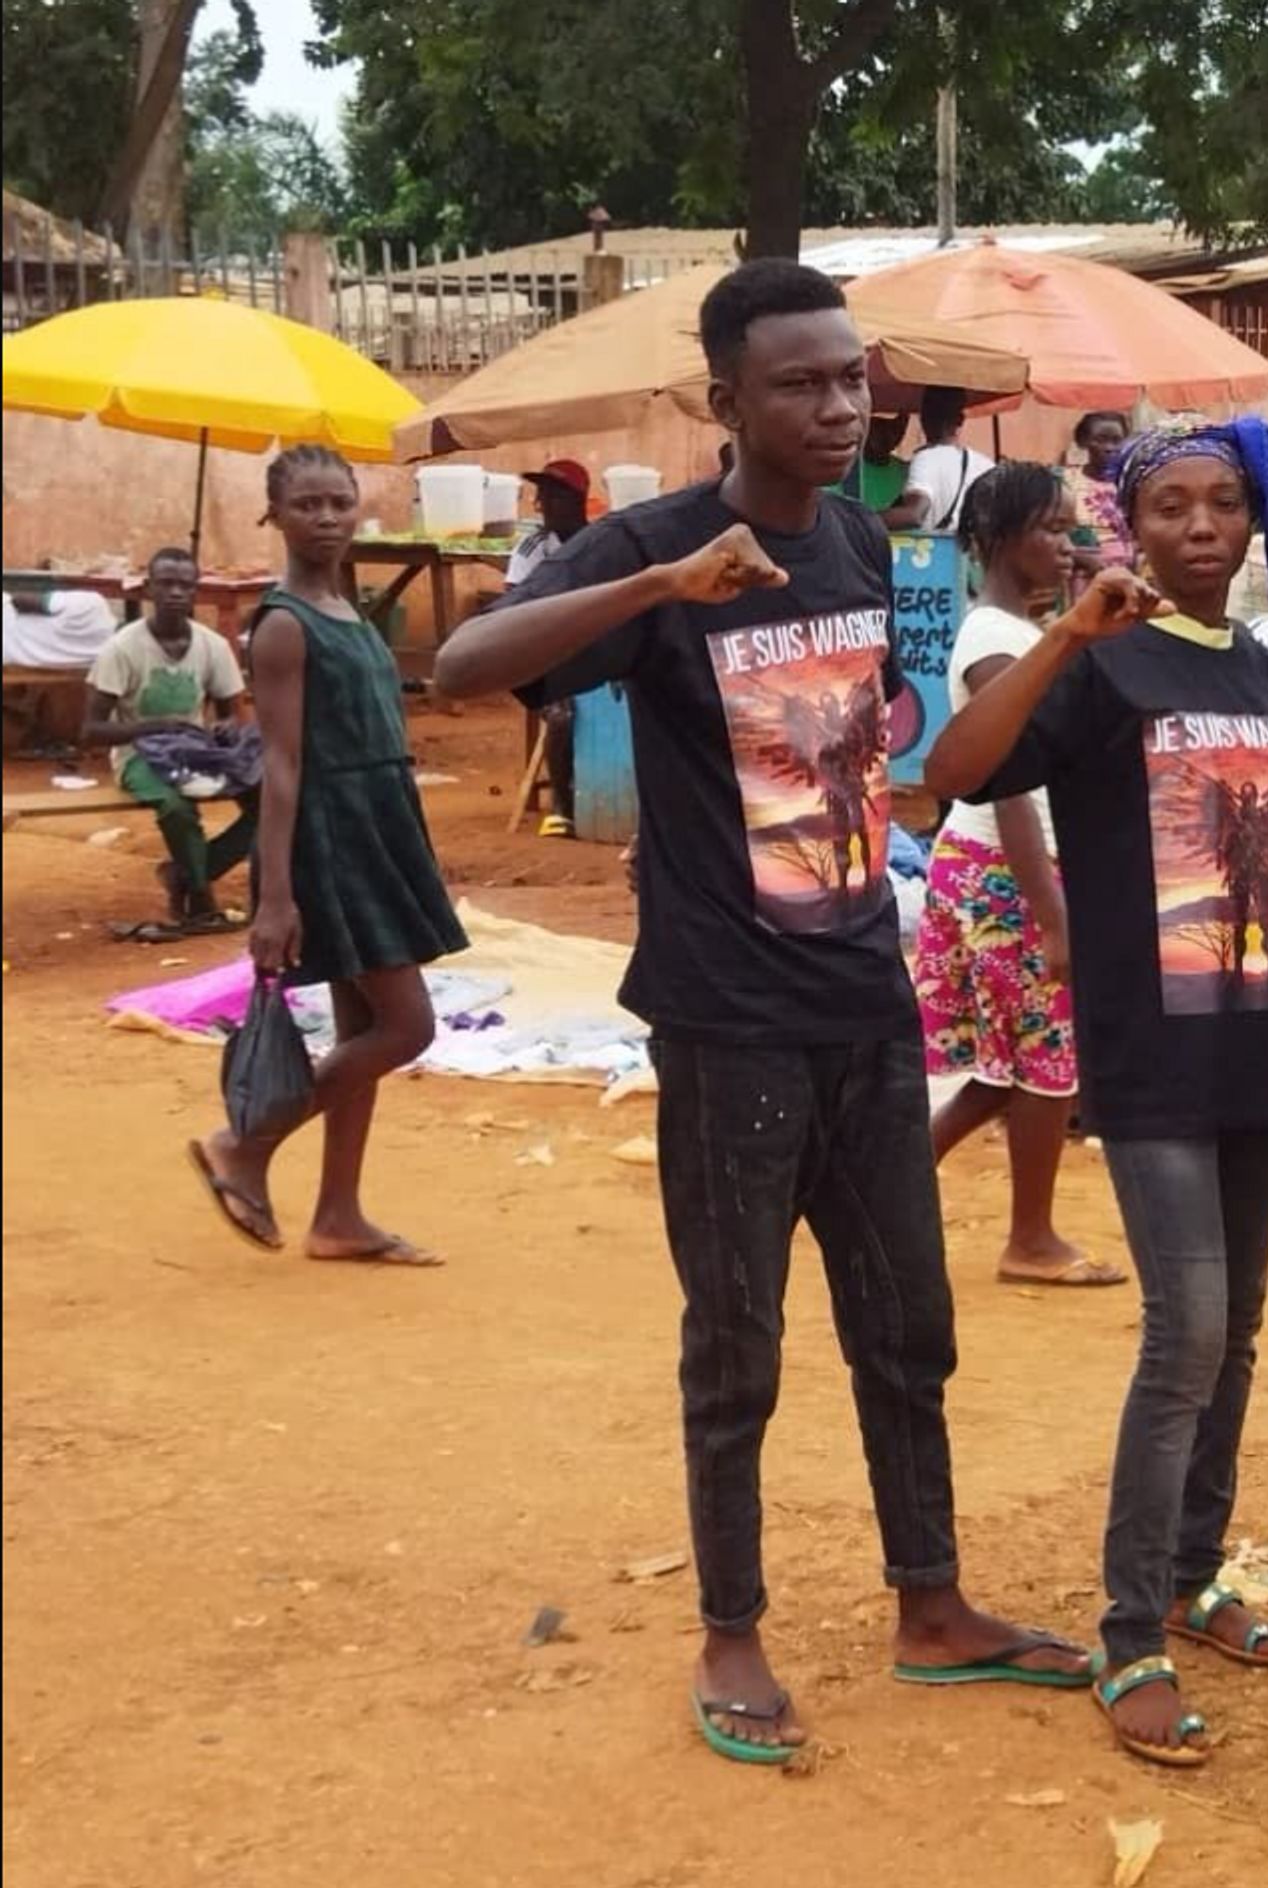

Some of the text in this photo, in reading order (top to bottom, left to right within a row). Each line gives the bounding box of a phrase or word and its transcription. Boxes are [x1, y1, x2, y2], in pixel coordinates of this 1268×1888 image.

[894, 586, 953, 623] ERE
[721, 634, 751, 675] JE
[752, 623, 806, 668] SUIS
[1152, 716, 1180, 754] JE
[1184, 714, 1236, 749] SUIS
